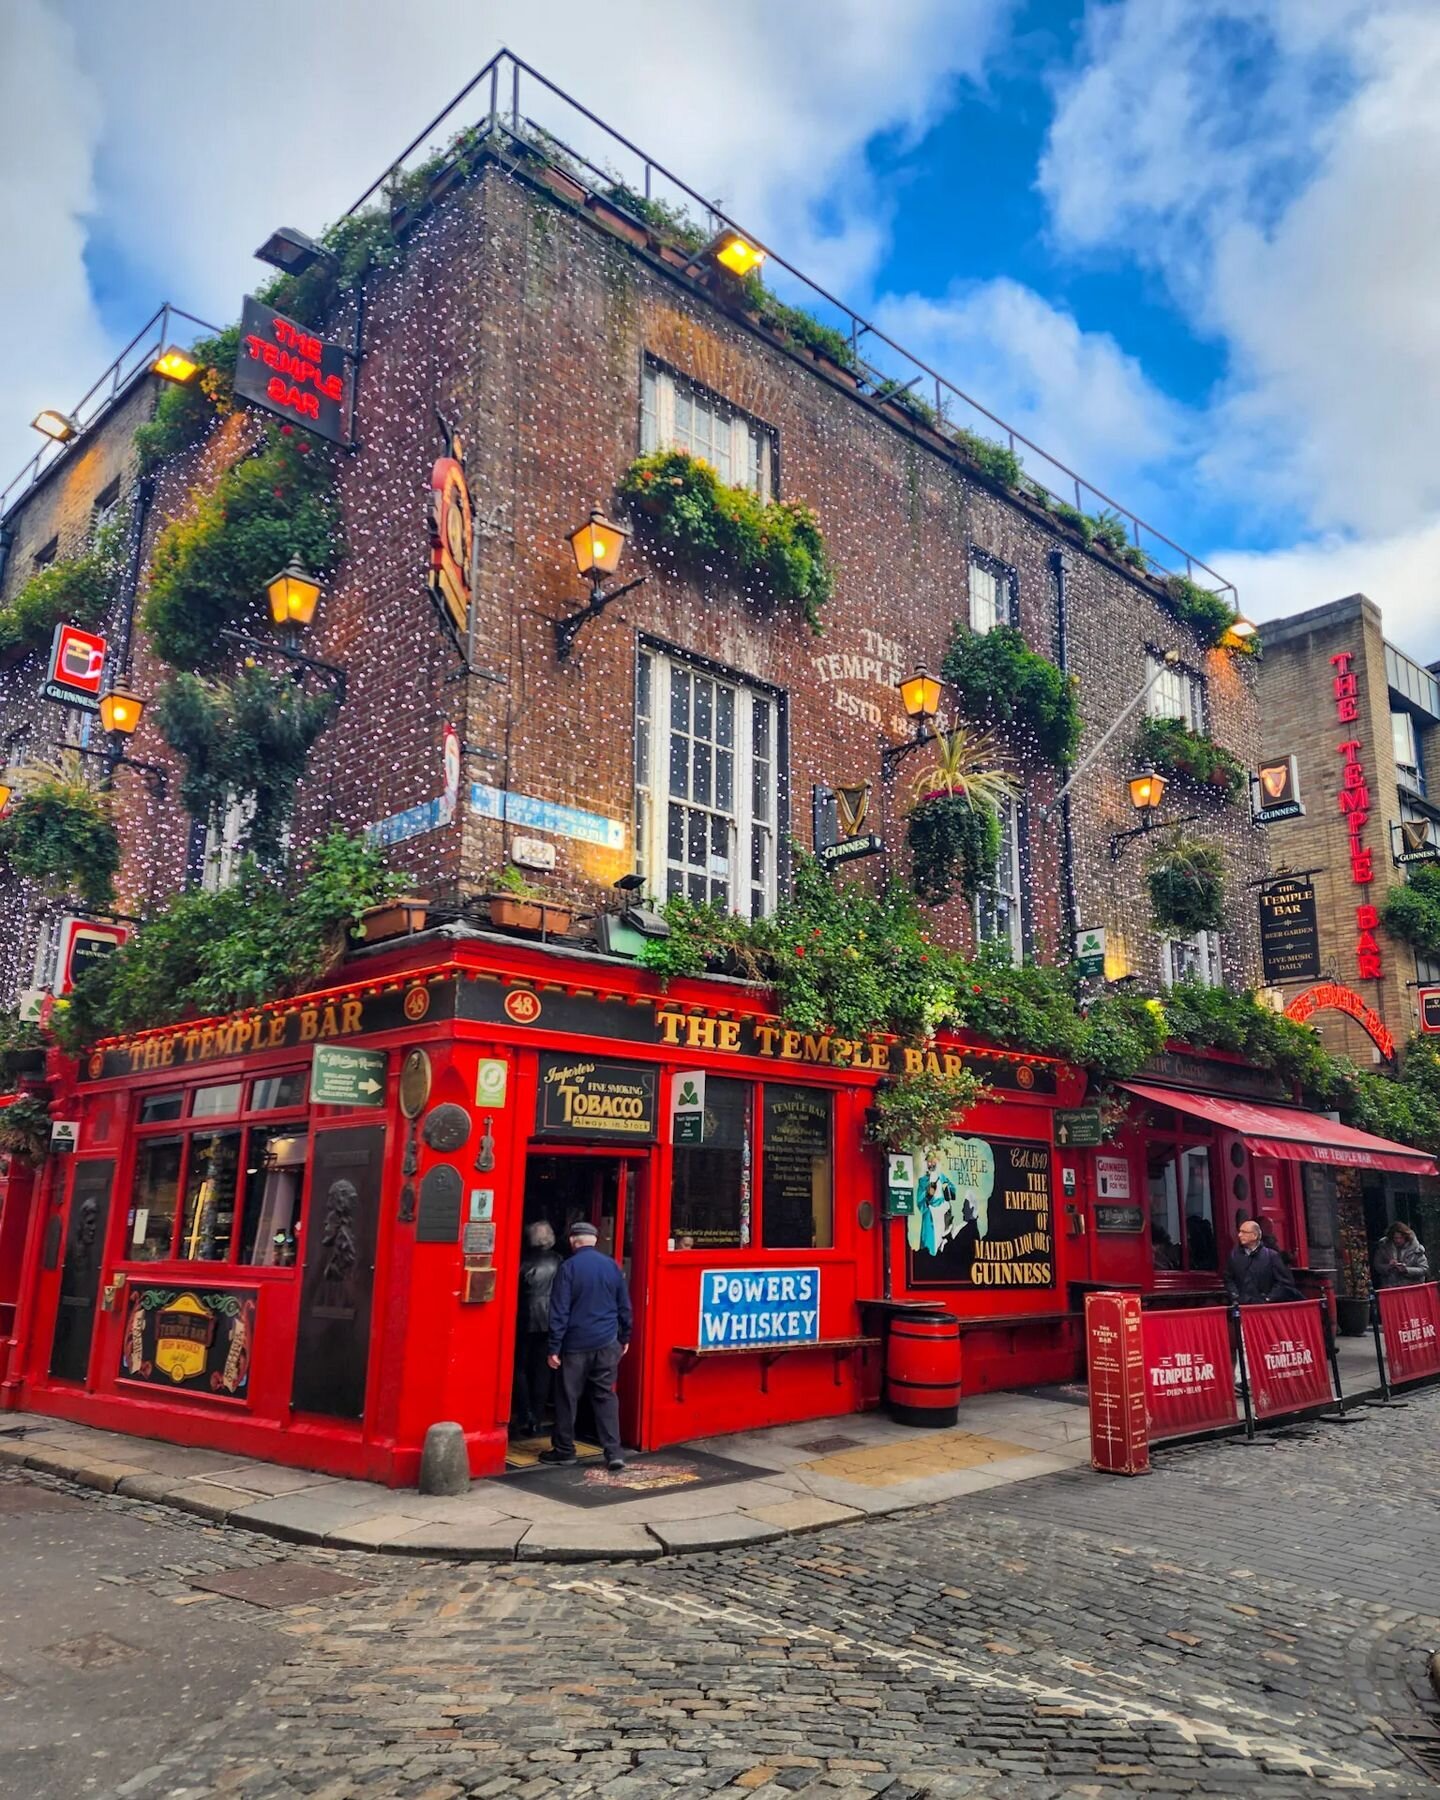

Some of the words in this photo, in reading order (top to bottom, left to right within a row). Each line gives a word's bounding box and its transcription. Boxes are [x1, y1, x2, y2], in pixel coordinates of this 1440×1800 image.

[272, 318, 322, 363] THE
[245, 335, 343, 401] TEMPLE
[267, 376, 319, 420] BAR
[861, 628, 905, 668] THE
[1329, 651, 1359, 723] THE
[1259, 805, 1299, 821] GUINNESS
[1337, 740, 1374, 884] TEMPLE
[825, 837, 870, 858] GUINNESS
[1399, 850, 1436, 862] GUINNESS
[1278, 885, 1295, 893] THE
[1262, 891, 1313, 906] TEMPLE
[1273, 904, 1301, 916] BAR
[1284, 927, 1313, 936] GARDEN
[1356, 904, 1385, 980] BAR
[1268, 956, 1287, 964] LIVE
[1288, 953, 1313, 962] MUSIC
[1279, 962, 1303, 971] DAILY
[408, 994, 425, 1013] 48
[510, 994, 534, 1016] 48
[129, 1036, 174, 1072] THE
[183, 1015, 286, 1061] TEMPLE
[300, 1000, 364, 1041] BAR
[656, 1011, 742, 1052] THE
[904, 1048, 963, 1078] BAR
[543, 1063, 595, 1086] Importers
[587, 1081, 607, 1092] FINE
[607, 1083, 643, 1095] SMOKING
[557, 1085, 643, 1122] TOBACCO
[771, 1102, 808, 1114] TEMPLE
[809, 1104, 827, 1119] BAR
[574, 1116, 608, 1128] Always
[624, 1120, 649, 1131] Stock
[955, 1141, 977, 1158] THE
[1312, 1146, 1330, 1159] THE
[1330, 1148, 1356, 1163] TEMPLE
[947, 1157, 988, 1173] TEMPLE
[1098, 1160, 1127, 1173] GUINNESS
[957, 1172, 979, 1187] BAR
[1027, 1173, 1048, 1191] THE
[1005, 1191, 1049, 1211] EMPEROR
[1037, 1213, 1048, 1230] OF
[974, 1239, 1014, 1261] MALTED
[1014, 1231, 1051, 1257] LIQUORS
[971, 1263, 1051, 1285] GUINNESS
[712, 1275, 812, 1304] POWER'S
[703, 1310, 817, 1342] WHISKEY
[1092, 1329, 1119, 1338] TEMPLE
[1398, 1328, 1422, 1343] TEMPLE
[1280, 1341, 1295, 1352] THE
[1174, 1353, 1192, 1366] THE
[1264, 1353, 1298, 1370] TEMPLE
[1296, 1349, 1313, 1365] BAR
[1150, 1367, 1193, 1386] TEMPLE
[1194, 1363, 1215, 1381] BAR
